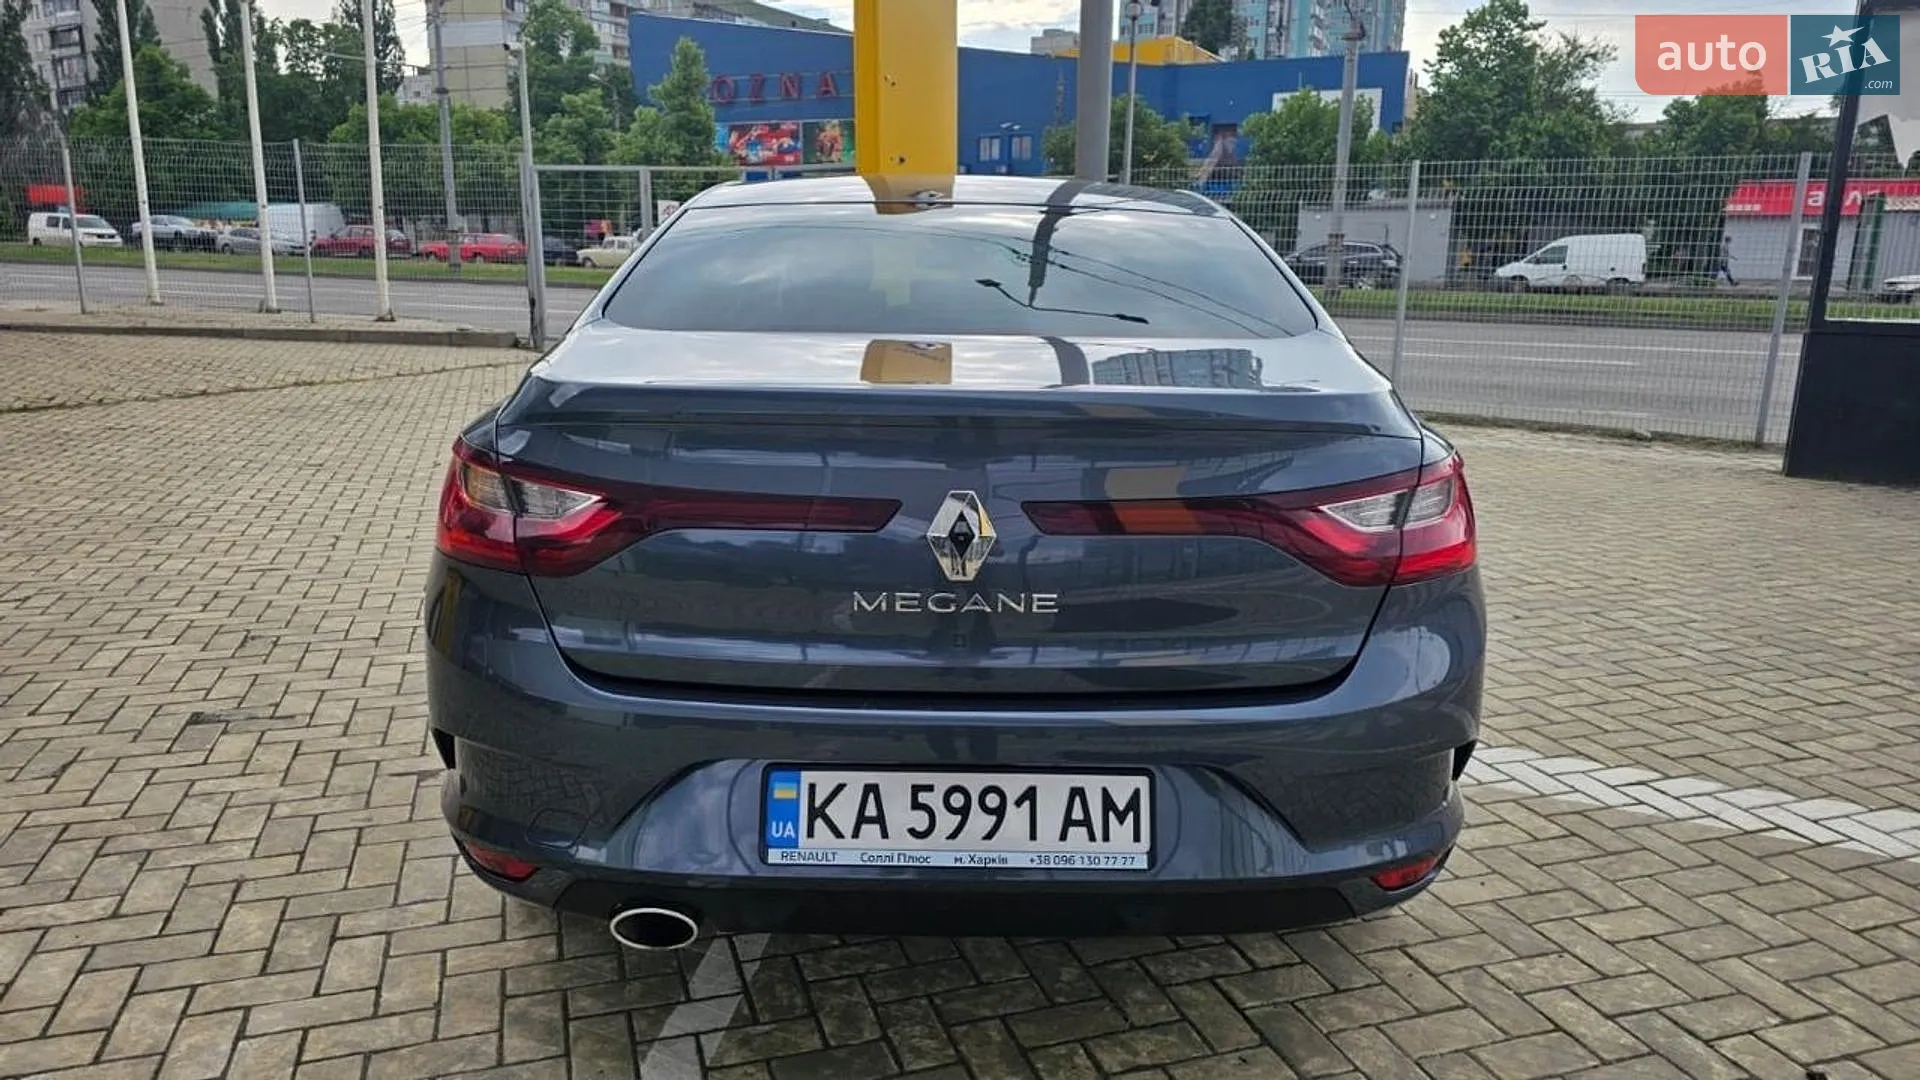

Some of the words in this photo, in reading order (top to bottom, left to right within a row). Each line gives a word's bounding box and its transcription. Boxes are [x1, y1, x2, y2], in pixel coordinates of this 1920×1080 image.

[853, 591, 1059, 613] MEGANE
[806, 782, 890, 840] KA
[907, 784, 1037, 842] 5991
[1059, 786, 1142, 843] AM
[771, 820, 796, 838] UA
[781, 851, 838, 862] RENAULT
[897, 853, 931, 864] Плюс
[969, 854, 1008, 868] Харків
[1030, 854, 1050, 865] +38
[1053, 855, 1075, 866] 096
[1079, 855, 1101, 866] 130
[1104, 856, 1118, 866] 77
[1122, 856, 1136, 866] 77
